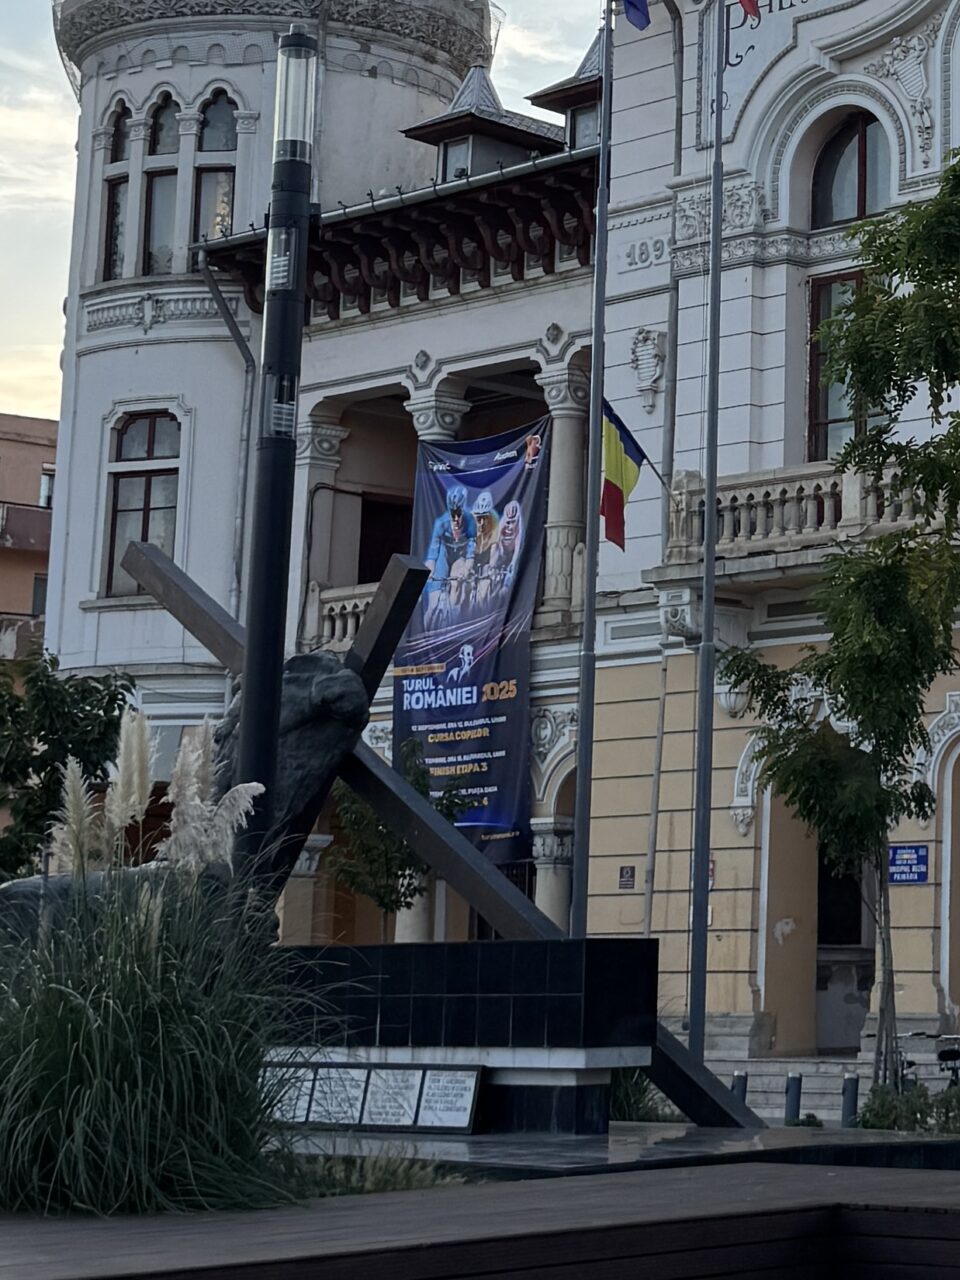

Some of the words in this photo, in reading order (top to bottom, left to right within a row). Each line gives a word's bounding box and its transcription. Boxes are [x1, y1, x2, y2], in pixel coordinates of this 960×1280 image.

[625, 235, 671, 266] 189
[402, 677, 435, 691] TURUL
[403, 685, 477, 710] ROMÂNIEI
[482, 680, 517, 702] 2025
[428, 731, 454, 743] CURSA
